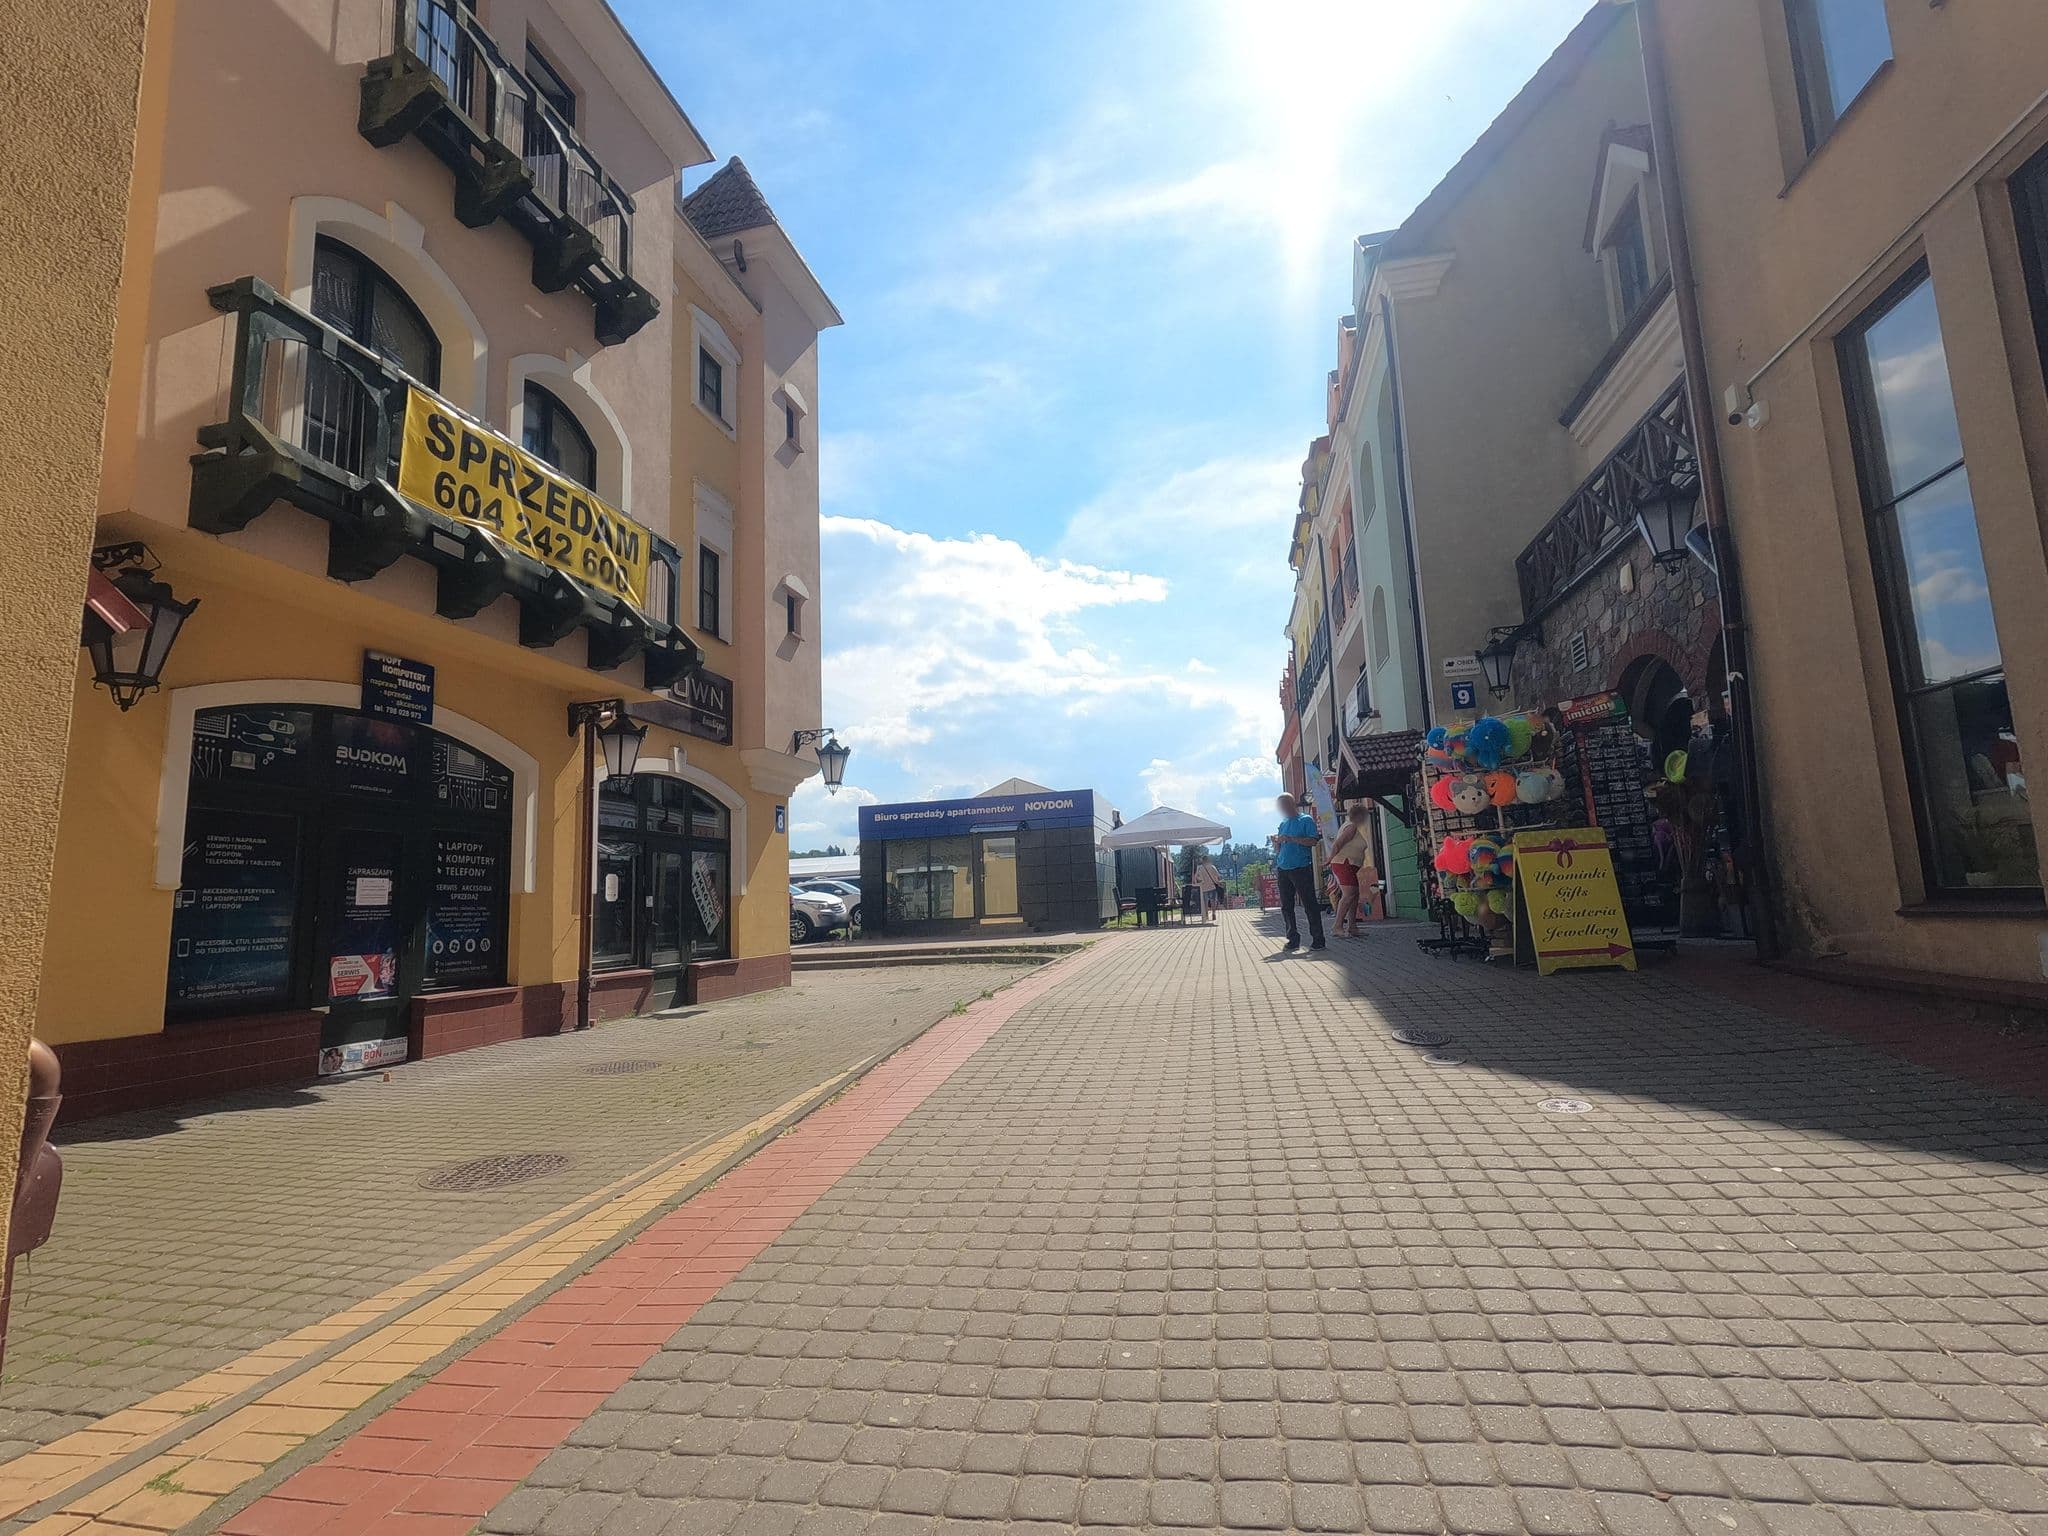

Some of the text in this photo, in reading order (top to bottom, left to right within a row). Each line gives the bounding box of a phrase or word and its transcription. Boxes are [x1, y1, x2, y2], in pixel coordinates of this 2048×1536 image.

[424, 413, 640, 565] SPRZEDAM
[434, 471, 504, 531] 604
[514, 512, 573, 566] 242
[382, 664, 426, 682] KOMPUTERY
[397, 678, 431, 693] TELEFONY
[1457, 689, 1470, 705] 9
[336, 745, 407, 775] BUDKOM
[874, 799, 1074, 822] Biuro sprzedaży apartamentów NOVDOM
[777, 814, 784, 829] 8
[446, 842, 483, 852] LAPTOPY
[446, 854, 495, 865] KOMPUTERY
[445, 867, 486, 877] TELEFONY
[1533, 867, 1607, 886] Upominki
[1555, 886, 1589, 902] Gifts
[1542, 907, 1617, 920] Biżuteria
[1542, 923, 1619, 942] Jewellery
[363, 1049, 382, 1060] BON
